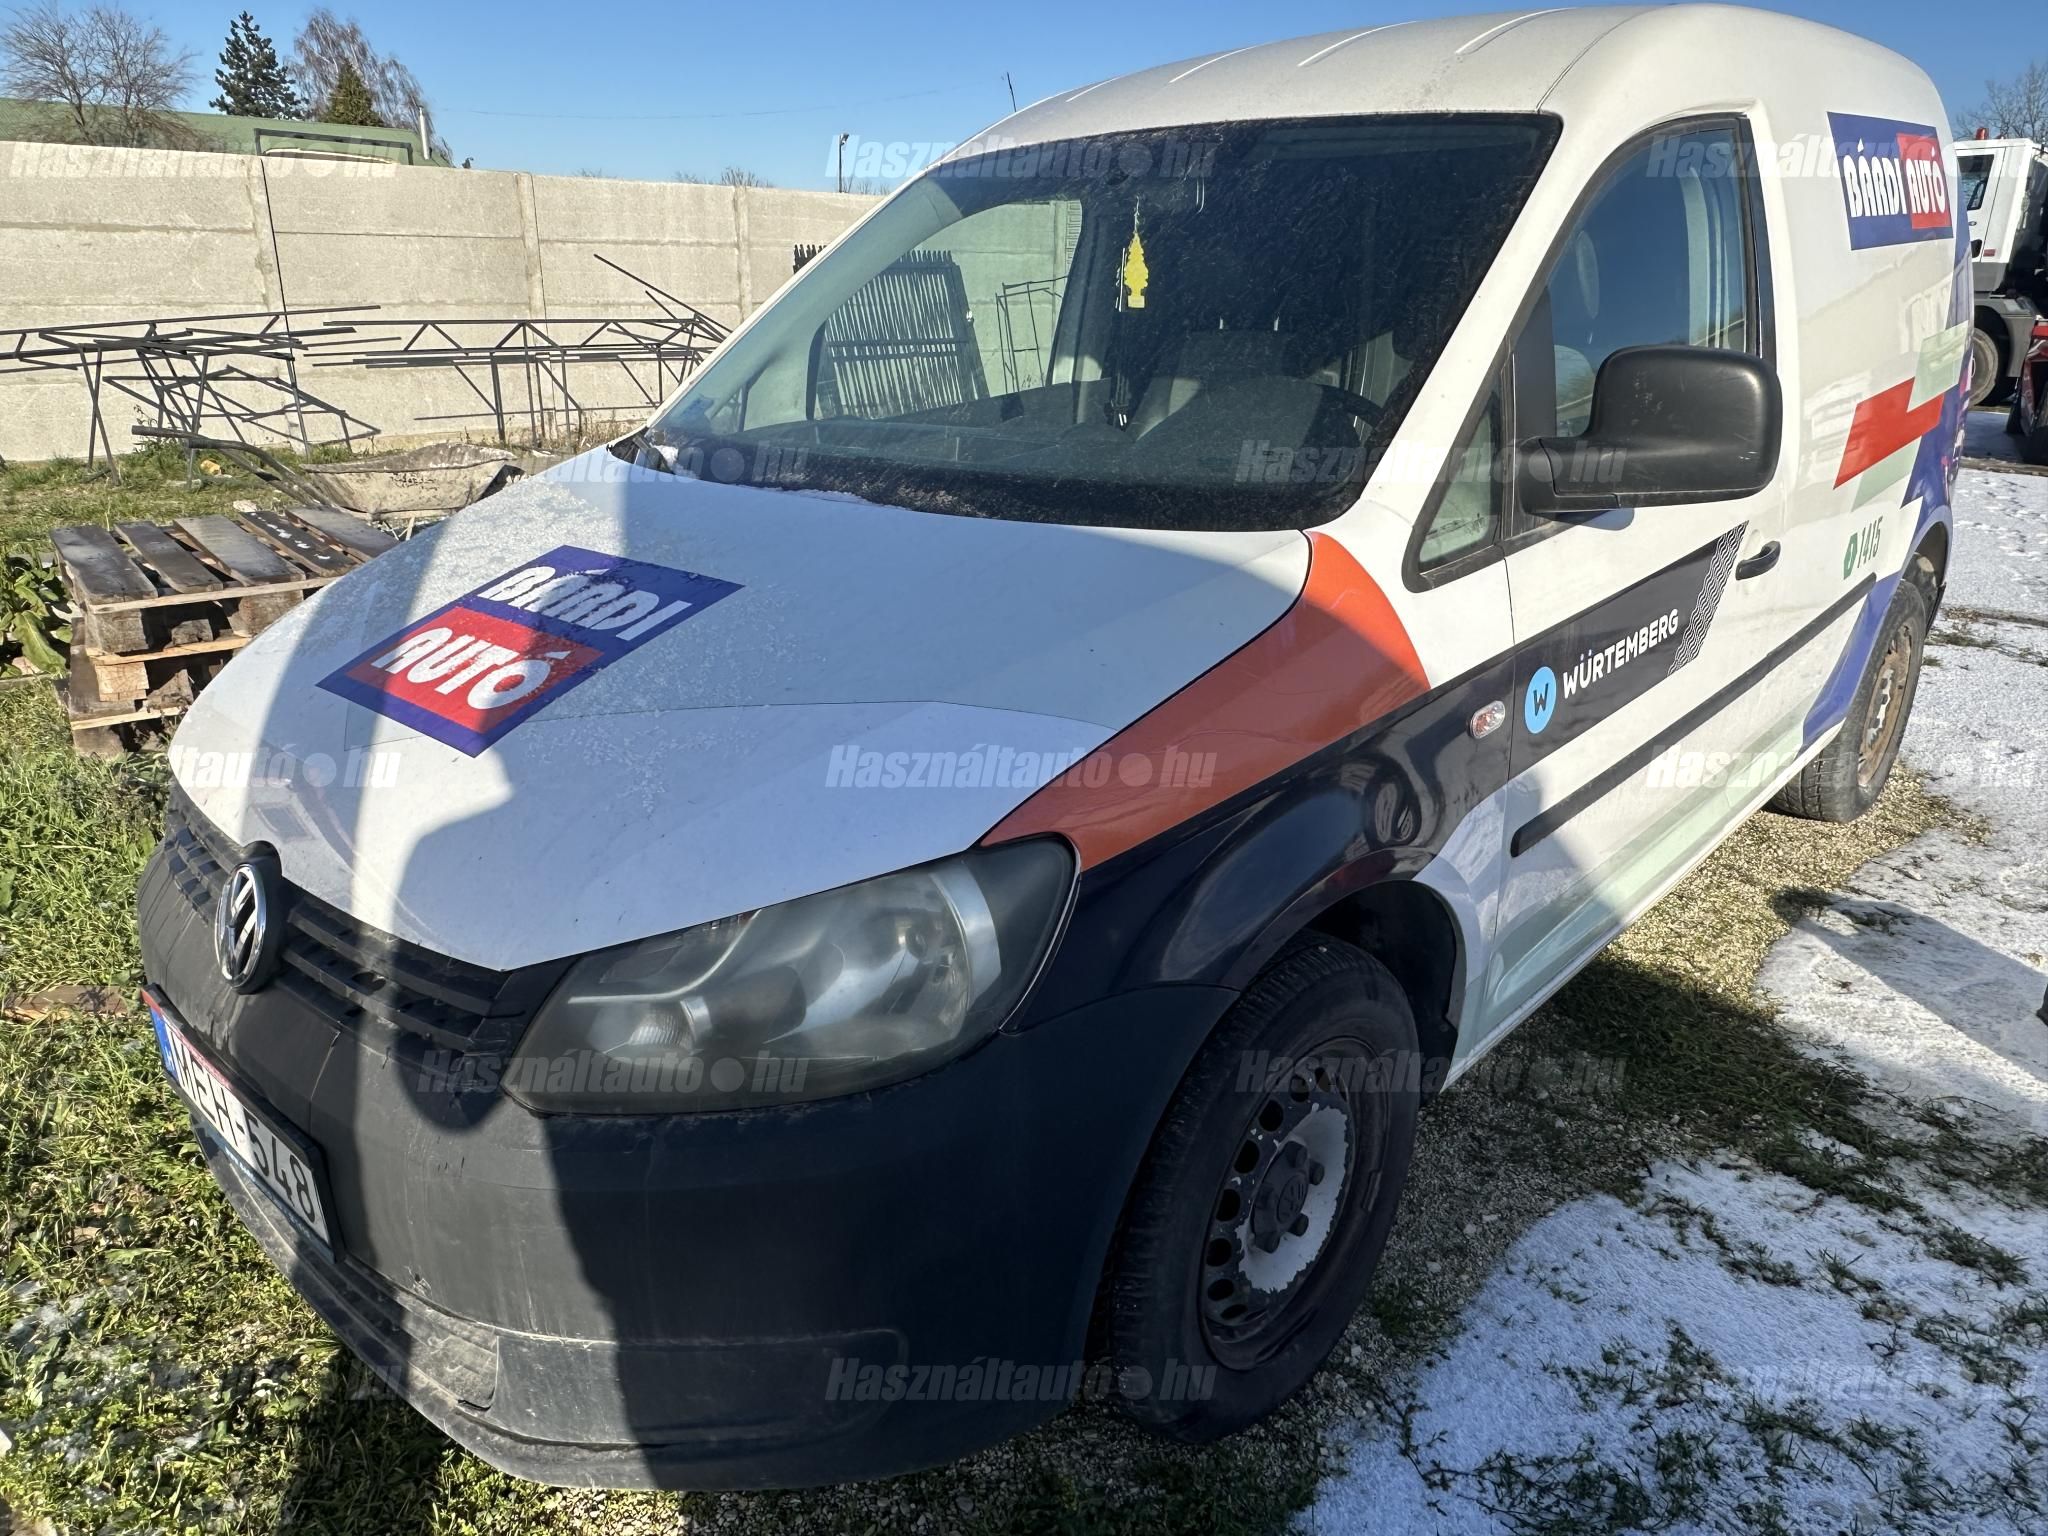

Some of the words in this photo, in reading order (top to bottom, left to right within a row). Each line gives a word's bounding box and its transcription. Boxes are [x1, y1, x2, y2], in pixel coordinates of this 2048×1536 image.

[1843, 138, 1907, 218] BÁRDI
[1905, 146, 1946, 214] AUTÓ
[1857, 515, 1883, 569] 1415
[477, 566, 693, 642] BÁRDI
[370, 626, 571, 710] AUTÓ
[1532, 682, 1550, 717] W
[1563, 608, 1679, 700] WÜRTEMBERG
